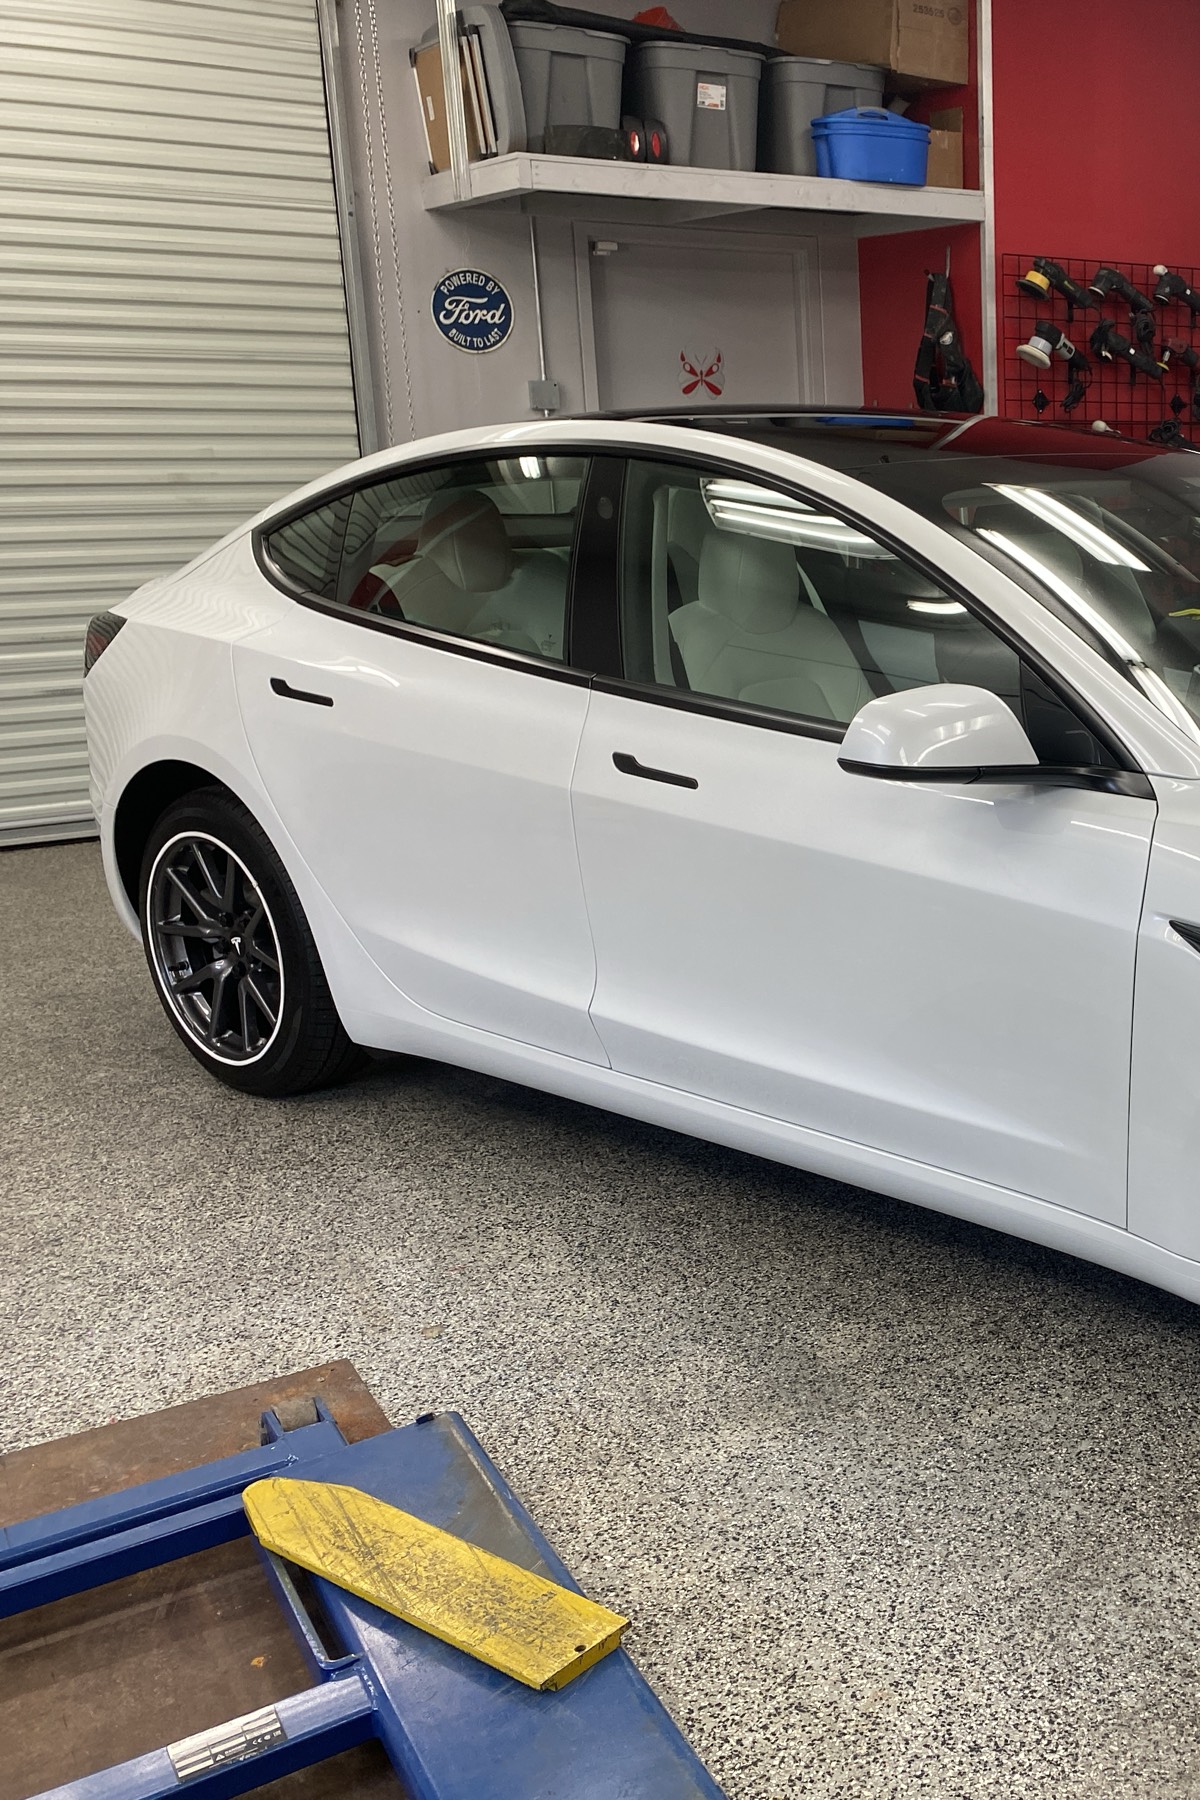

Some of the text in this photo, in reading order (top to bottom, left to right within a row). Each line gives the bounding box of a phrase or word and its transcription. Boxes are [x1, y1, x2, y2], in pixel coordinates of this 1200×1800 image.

[440, 273, 500, 295] POWERED BY
[439, 296, 505, 325] Ford
[449, 328, 503, 348] BUILT TO LAST
